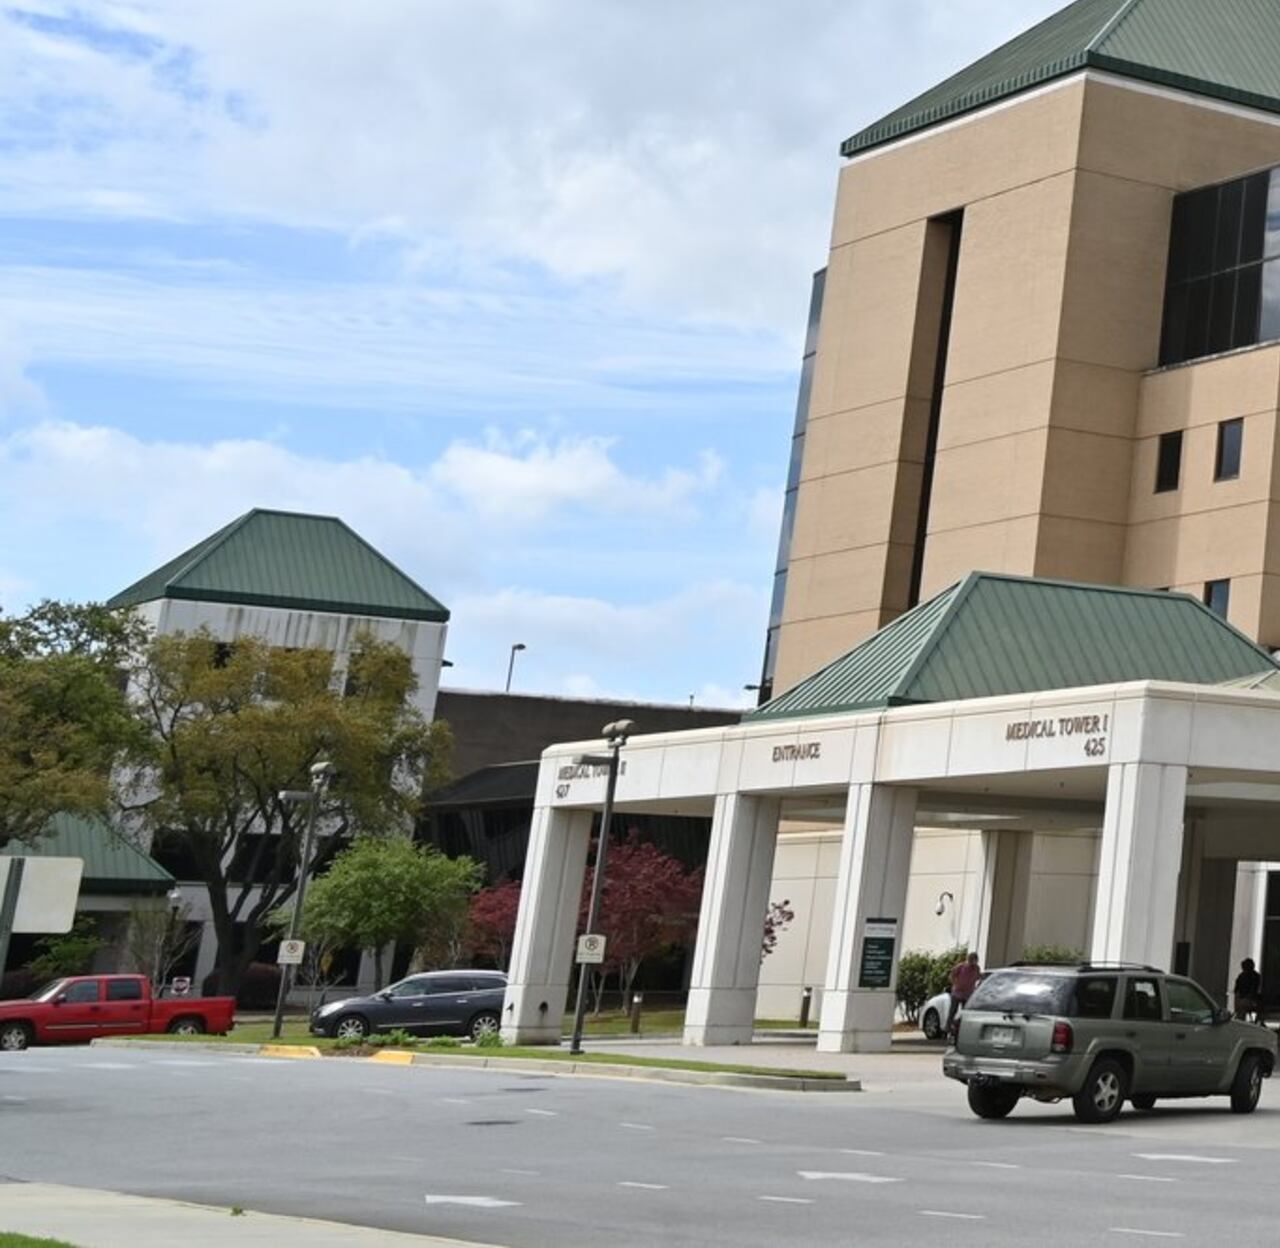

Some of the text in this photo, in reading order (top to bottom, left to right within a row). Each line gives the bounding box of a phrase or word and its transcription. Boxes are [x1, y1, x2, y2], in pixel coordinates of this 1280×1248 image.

[1006, 719, 1055, 741] MEDICAL
[1059, 715, 1100, 735] TOWER
[772, 742, 821, 763] ENTRANCE
[1084, 737, 1106, 756] 425
